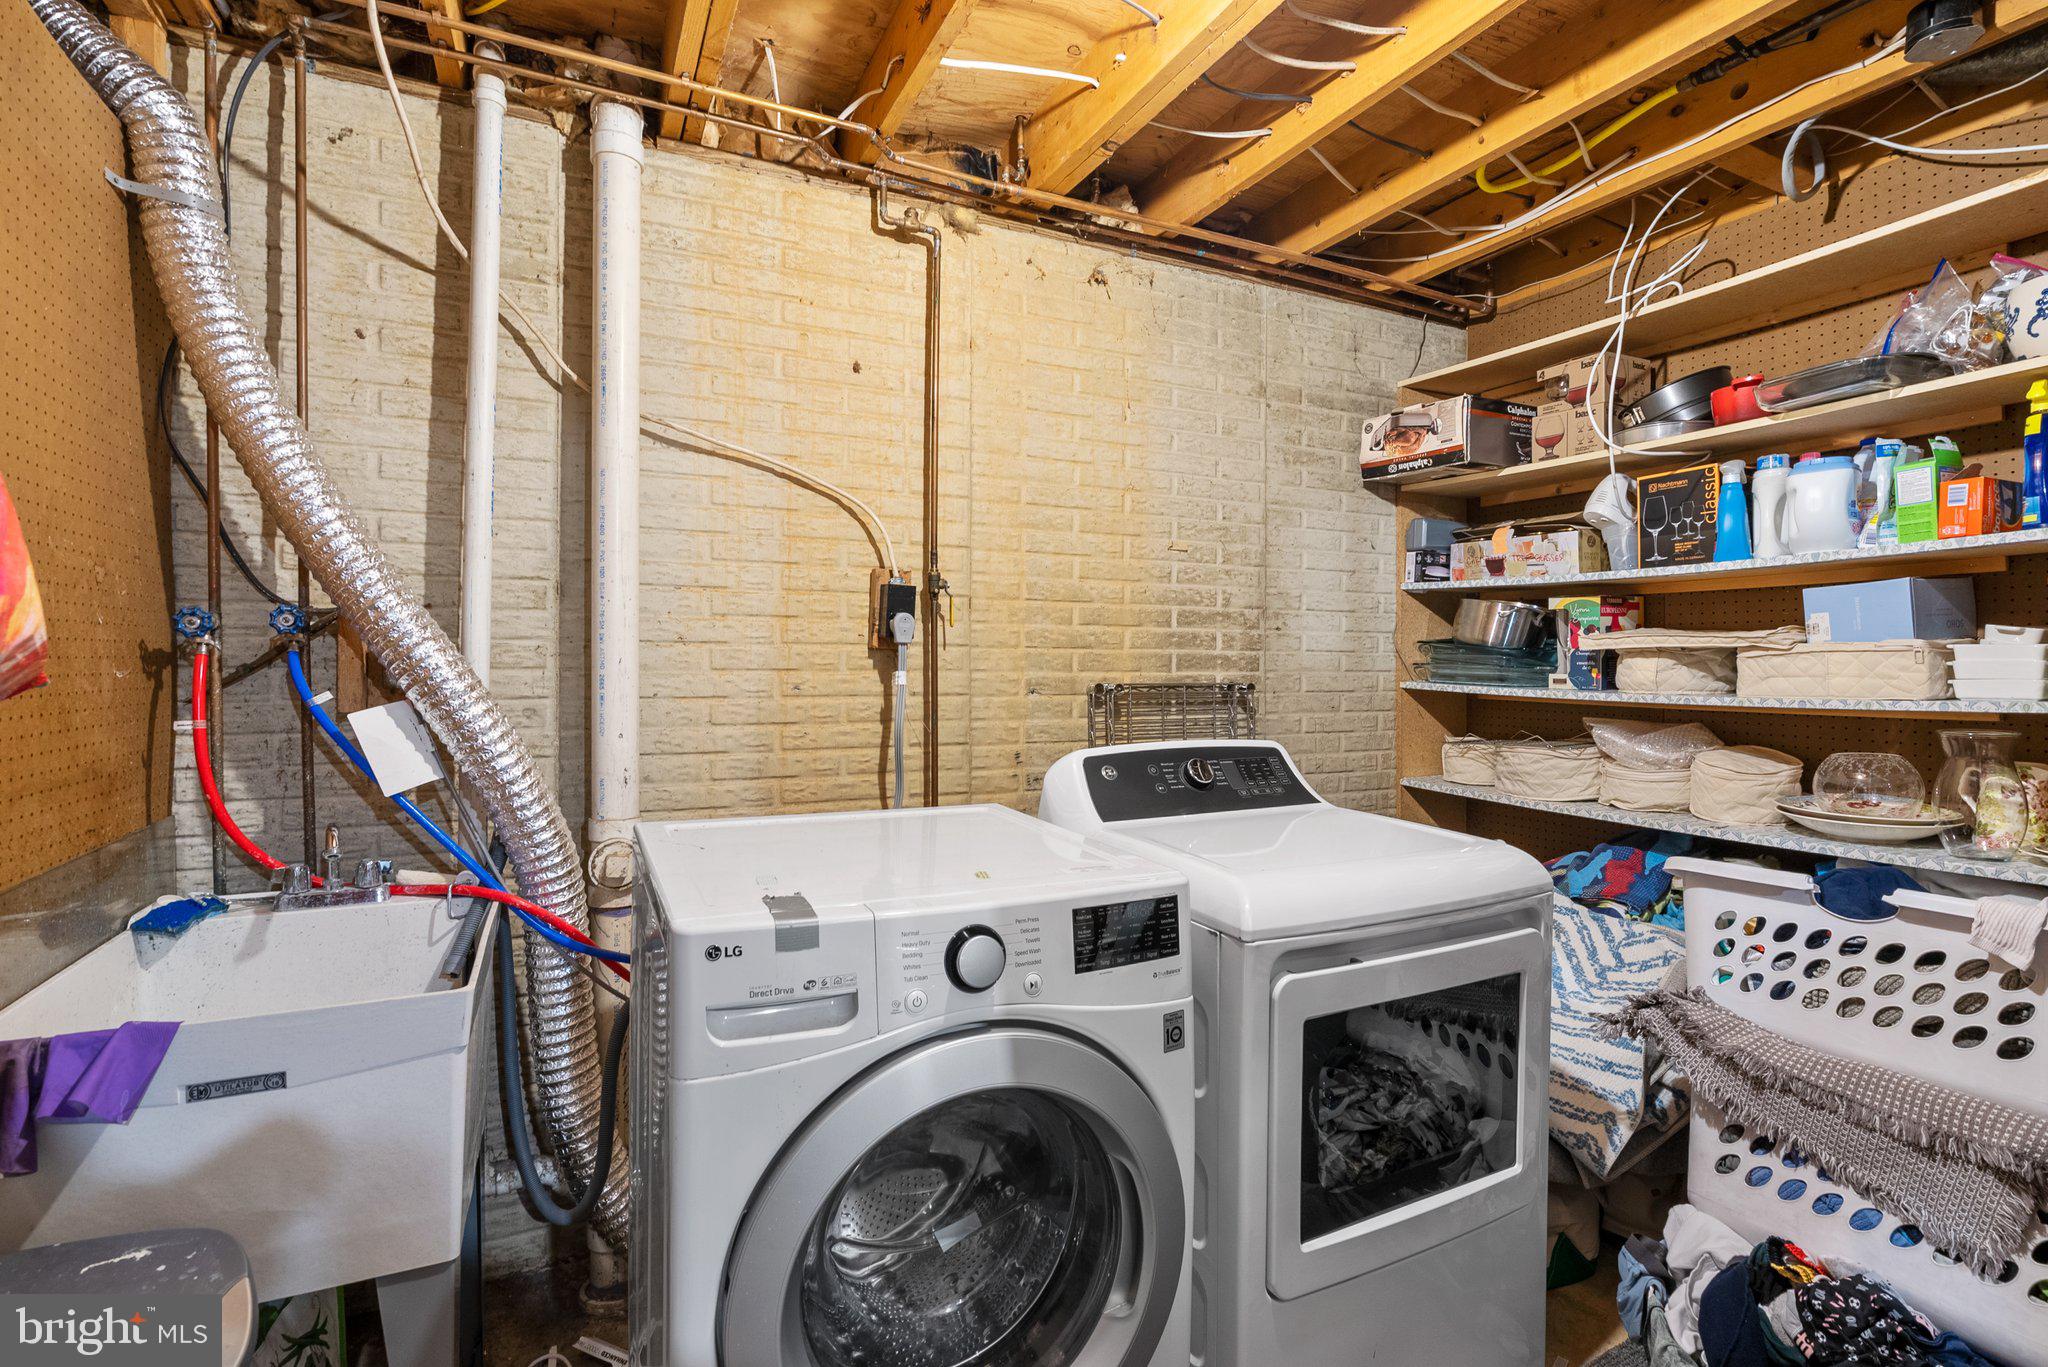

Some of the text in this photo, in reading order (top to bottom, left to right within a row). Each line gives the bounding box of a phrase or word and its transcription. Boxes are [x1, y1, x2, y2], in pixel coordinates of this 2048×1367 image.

[1398, 458, 1433, 471] Calphalon
[1700, 467, 1716, 524] classic
[901, 929, 920, 937] Normal
[1020, 926, 1040, 934] Delicates
[724, 945, 743, 958] LG
[902, 951, 923, 959] Bedding
[903, 963, 921, 971] Whites
[1015, 959, 1042, 968] Downloaded
[749, 986, 795, 998] Direct Drive
